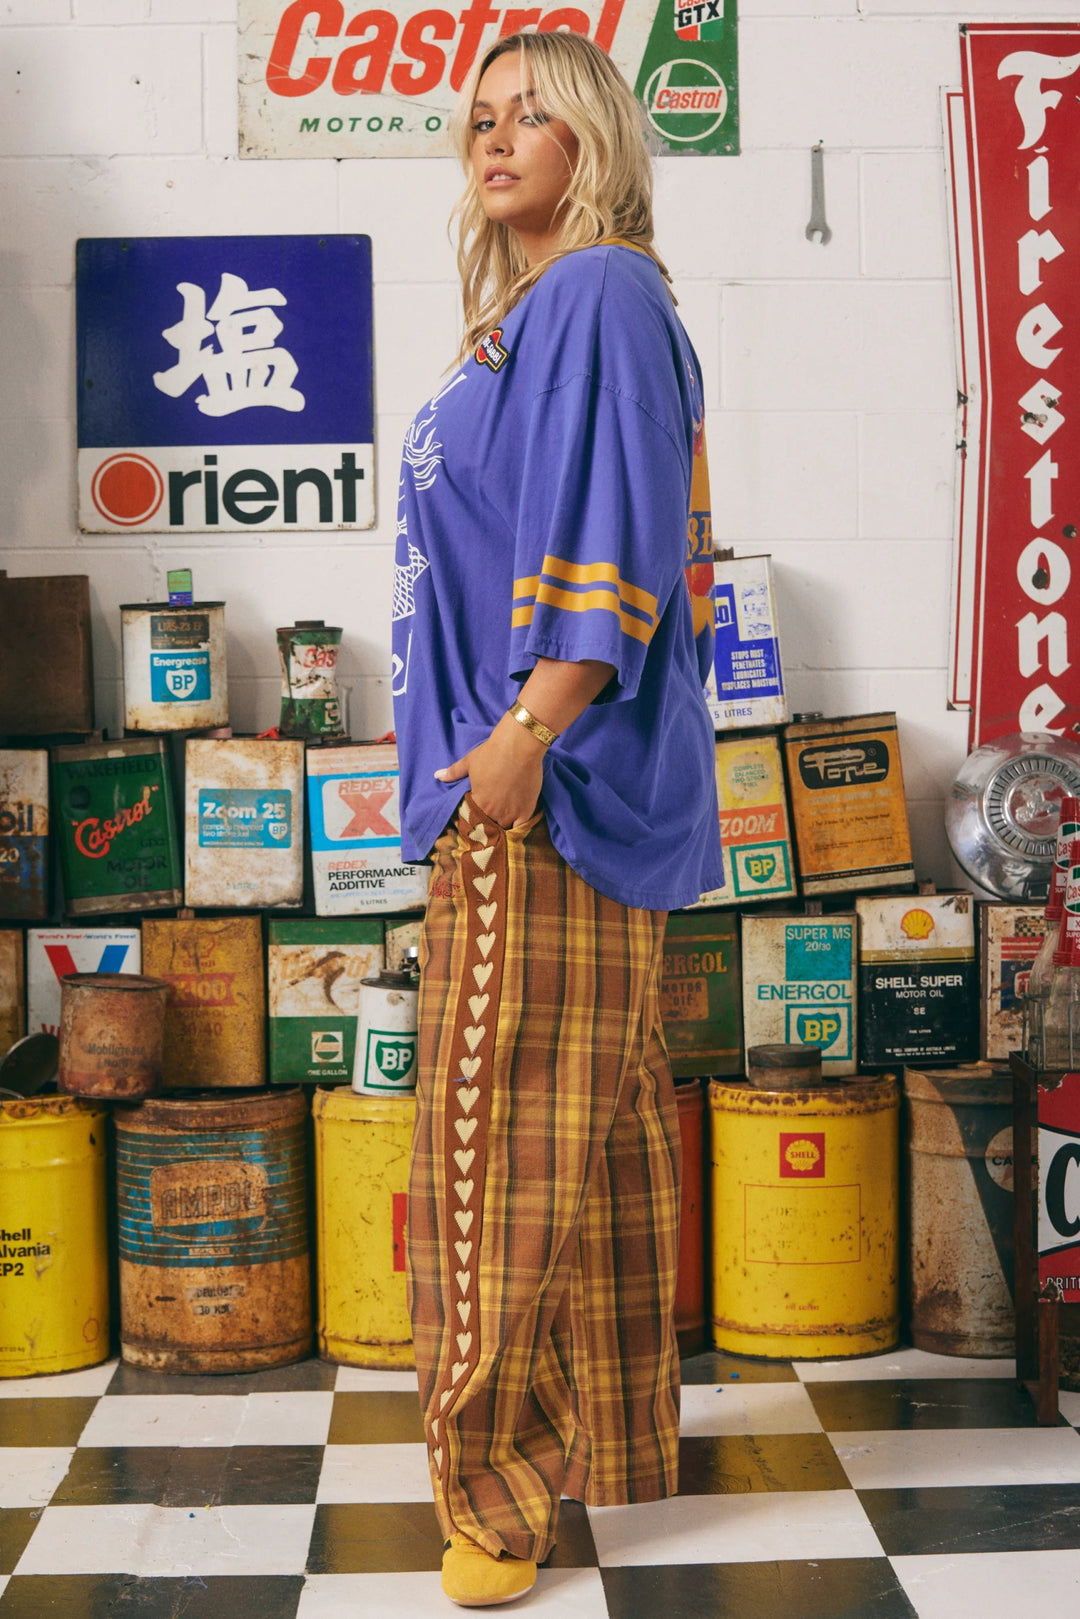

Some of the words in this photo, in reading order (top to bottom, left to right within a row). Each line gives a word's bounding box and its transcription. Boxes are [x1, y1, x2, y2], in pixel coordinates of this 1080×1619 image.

[678, 0, 720, 27] GTX
[656, 89, 723, 110] Castrol
[300, 117, 402, 133] MOTOR
[153, 272, 306, 417] 塩
[997, 50, 1080, 738] Firestone
[731, 650, 750, 660] STOPS
[750, 648, 764, 659] RUST
[153, 657, 208, 669] Energrease
[732, 658, 766, 670] PENETRATES
[733, 668, 767, 680] LUBRICATES
[171, 675, 194, 690] BP
[714, 710, 720, 719] 5
[724, 707, 753, 718] LITRES
[66, 758, 158, 779] WAKEFIELD
[338, 779, 395, 795] REDEX
[203, 802, 257, 819] Zoom
[262, 802, 286, 819] 25
[272, 825, 286, 835] BP
[719, 811, 778, 838] ZOOM
[0, 847, 19, 862] 20
[328, 860, 367, 870] REDEX
[749, 858, 774, 877] BP
[328, 867, 417, 881] PERFORMANCE
[329, 879, 386, 891] ADDITIVE
[787, 927, 828, 940] SUPER
[832, 926, 852, 940] MS
[805, 940, 832, 952] 20/30
[662, 951, 728, 976] ERGOL
[662, 982, 702, 993] MOTOR
[875, 976, 917, 989] SHELL
[920, 974, 963, 988] SUPER
[757, 983, 853, 1001] ENERGOL
[895, 990, 927, 999] MOTOR
[929, 989, 944, 998] OIL
[913, 1006, 926, 1015] SE
[804, 1020, 838, 1042] BP
[380, 1046, 413, 1072] BP
[322, 1069, 348, 1077] GALLON
[790, 1150, 816, 1160] SHELL
[160, 1180, 259, 1220] AMPOL
[0, 1228, 31, 1241] hell
